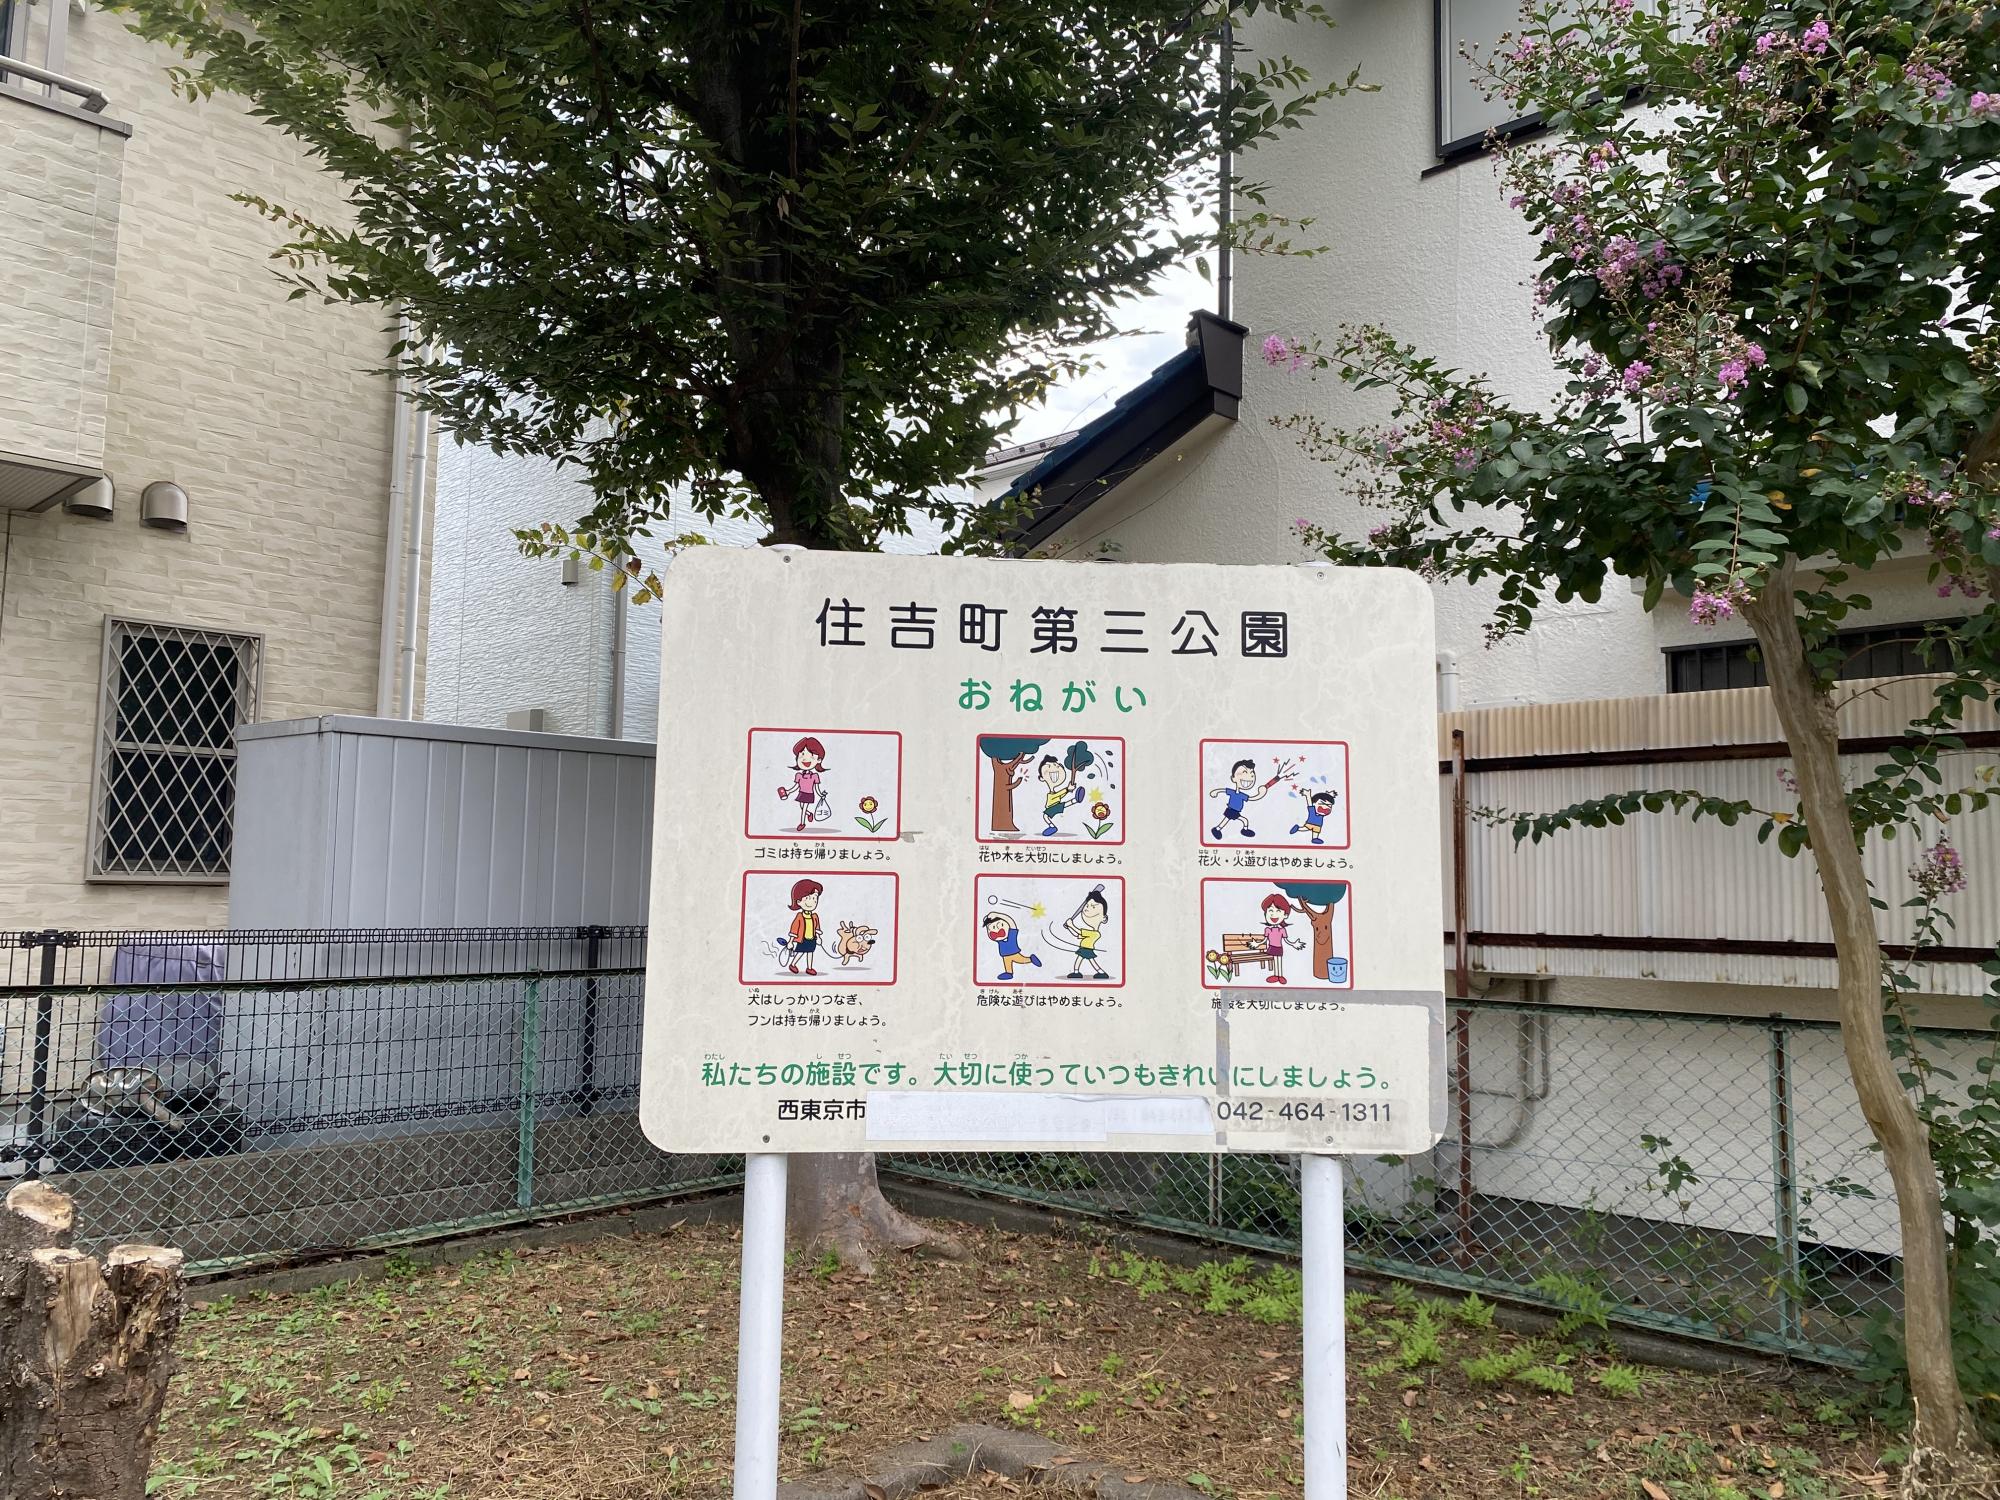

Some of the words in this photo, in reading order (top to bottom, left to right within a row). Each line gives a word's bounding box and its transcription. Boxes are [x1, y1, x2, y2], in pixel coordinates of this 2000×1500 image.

[815, 597, 1288, 658] 住吉町第三公園
[958, 677, 1147, 713] おねがい
[754, 847, 891, 861] ゴミは持ち帰りましょう。
[978, 851, 1122, 865] 花や木を大切にしましょう。
[1198, 855, 1354, 870] 花火・火遊びはやめましょう。
[747, 994, 864, 1006] 犬はしっかりつなぎ、
[976, 994, 1123, 1008] 危険な遊びはやめましょう。
[747, 1014, 887, 1027] フンは持ち帰りましょう。
[778, 1099, 867, 1121] 西東京市
